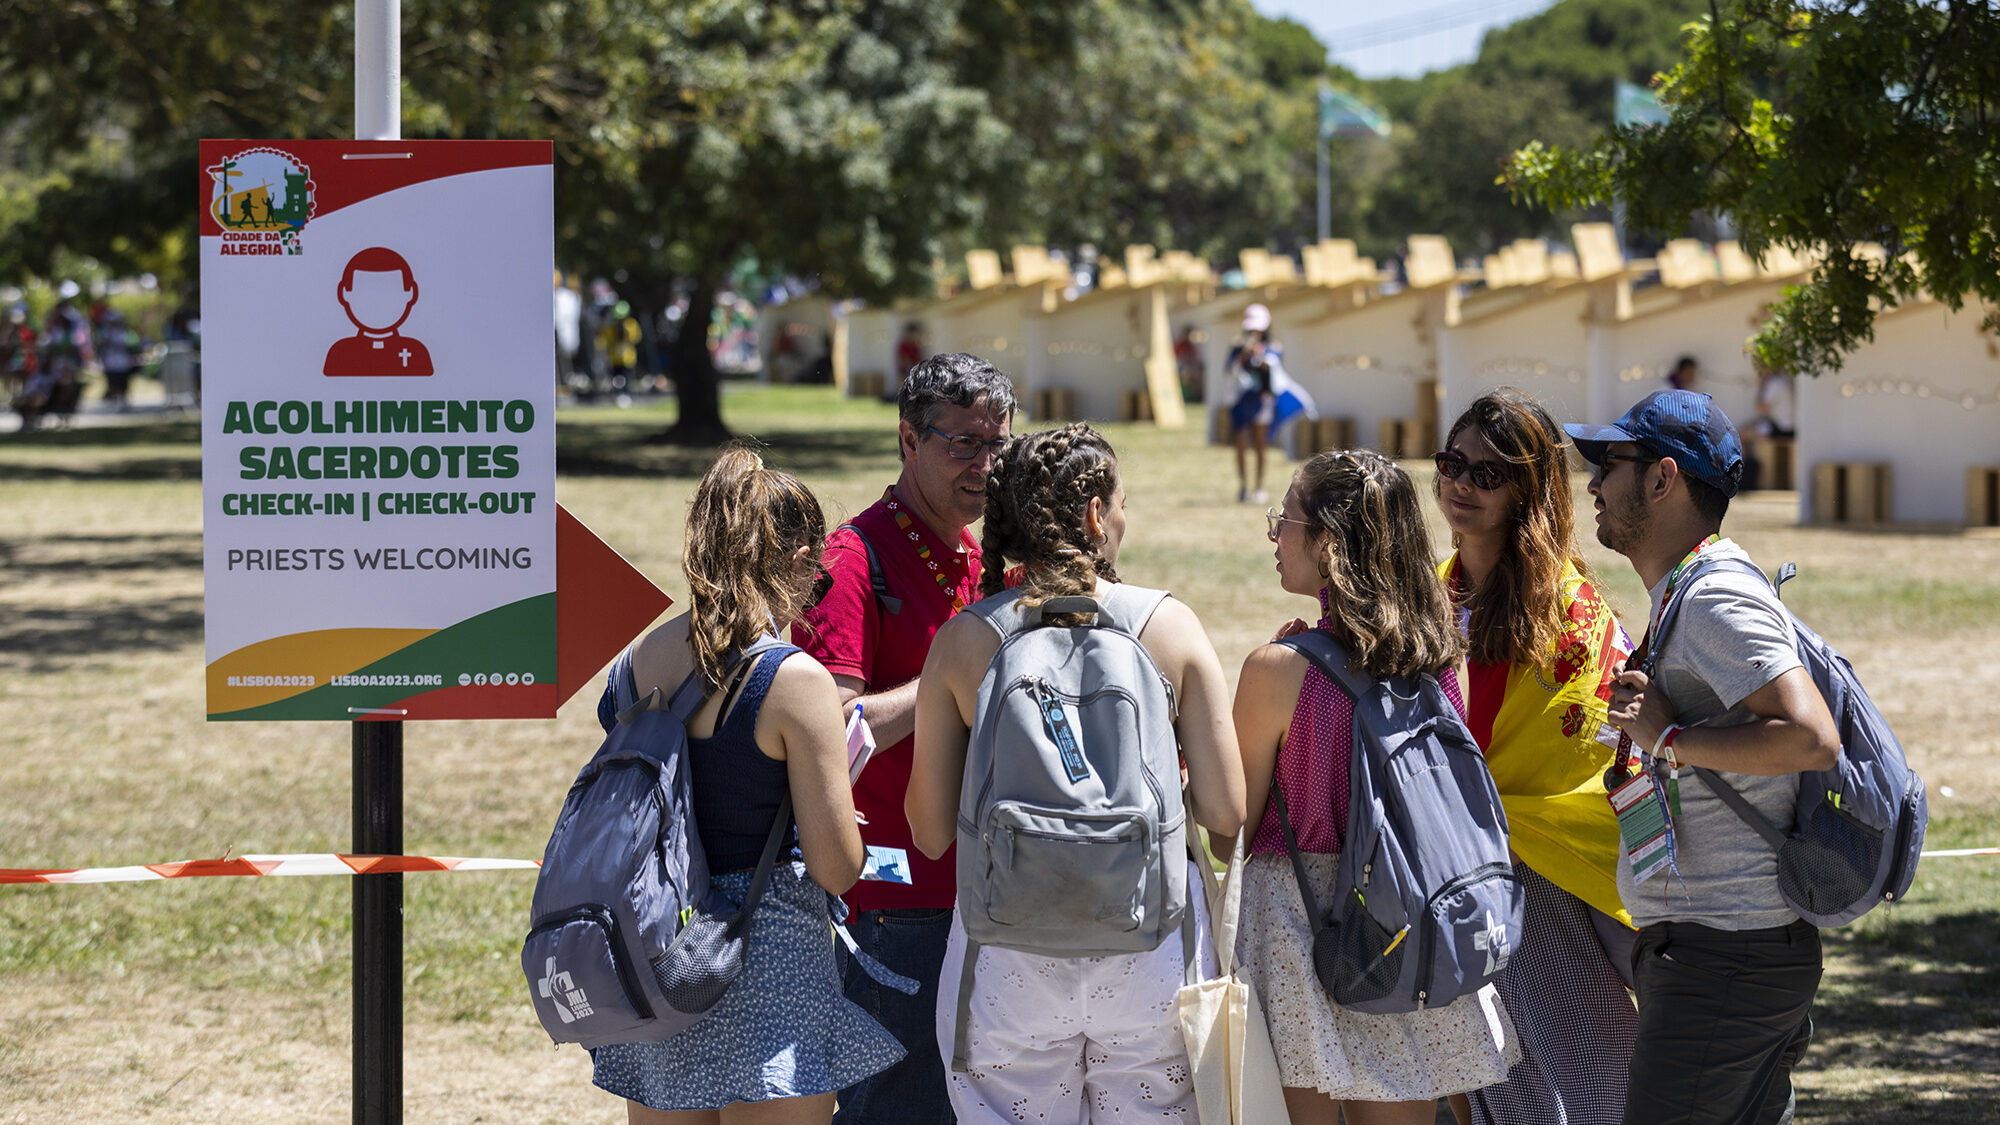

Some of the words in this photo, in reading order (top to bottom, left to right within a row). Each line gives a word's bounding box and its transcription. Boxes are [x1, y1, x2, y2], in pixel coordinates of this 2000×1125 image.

[222, 232, 262, 242] CIDADE
[264, 232, 281, 242] DA
[220, 243, 283, 256] ALEGRIA
[222, 399, 535, 435] ACOLHIMENTO
[239, 444, 520, 480] SACERDOTES
[222, 492, 355, 516] CHECK-IN
[377, 491, 537, 515] CHECK-OUT
[228, 548, 345, 571] PRIESTS
[353, 547, 532, 570] WELCOMING
[227, 674, 316, 687] #LISBOA2023
[330, 673, 443, 687] LISBOA2023.ORG
[574, 1007, 594, 1019] 2023
